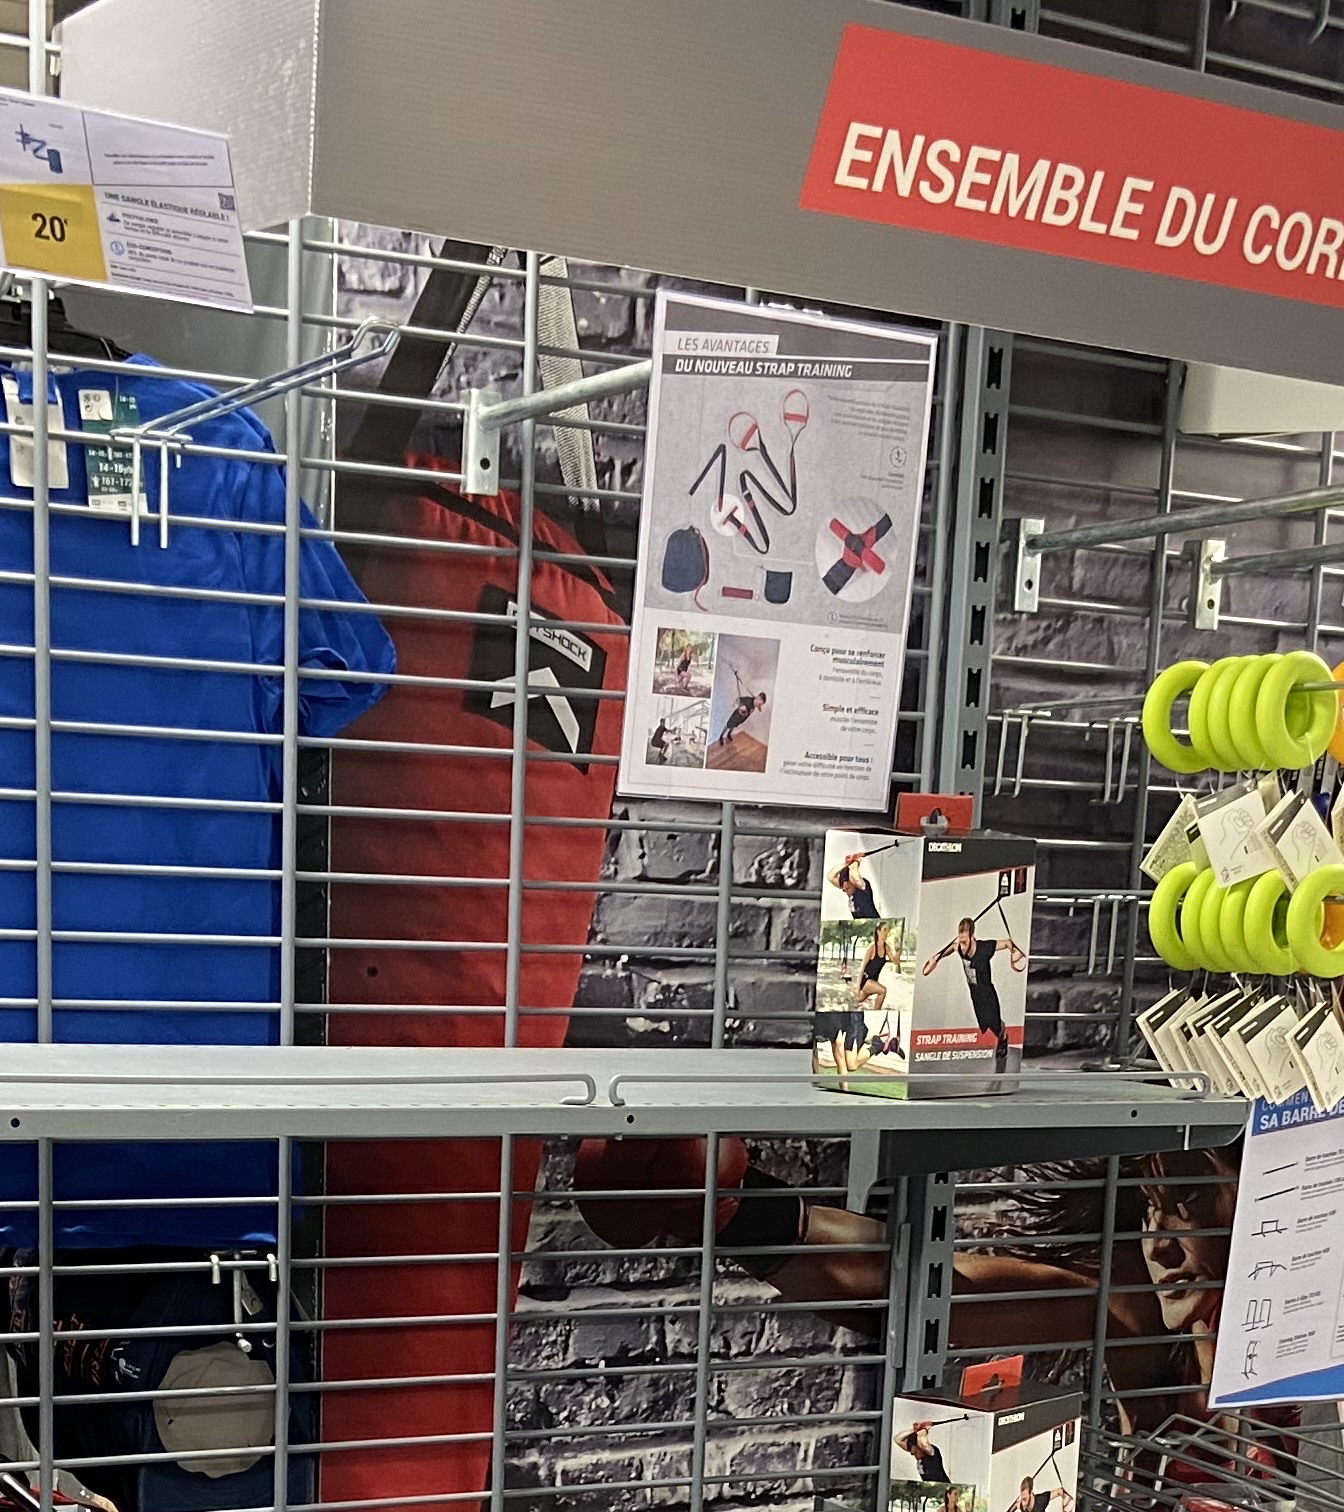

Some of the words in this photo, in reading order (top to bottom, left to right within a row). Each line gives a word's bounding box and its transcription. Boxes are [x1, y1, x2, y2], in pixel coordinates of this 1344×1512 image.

[834, 121, 1155, 241] ENSEMBLE
[1155, 186, 1238, 256] DU
[677, 337, 699, 351] LES
[702, 338, 770, 354] AVANTAGES
[675, 358, 694, 372] DU
[694, 360, 753, 375] NOUVEAU
[755, 362, 795, 376] STRAP
[797, 363, 853, 378] TRAINING
[810, 644, 831, 656] Conçu
[831, 648, 847, 656] pour
[856, 650, 886, 659] renforcer
[822, 703, 845, 714] Simple
[846, 706, 853, 714] et
[853, 707, 879, 716] efficace
[804, 751, 838, 761] Accessible
[838, 755, 854, 764] pour
[916, 1034, 942, 1046] STRAP
[915, 1051, 942, 1062] SANGLE
[942, 1050, 952, 1060] DE
[1260, 1114, 1279, 1131] SA
